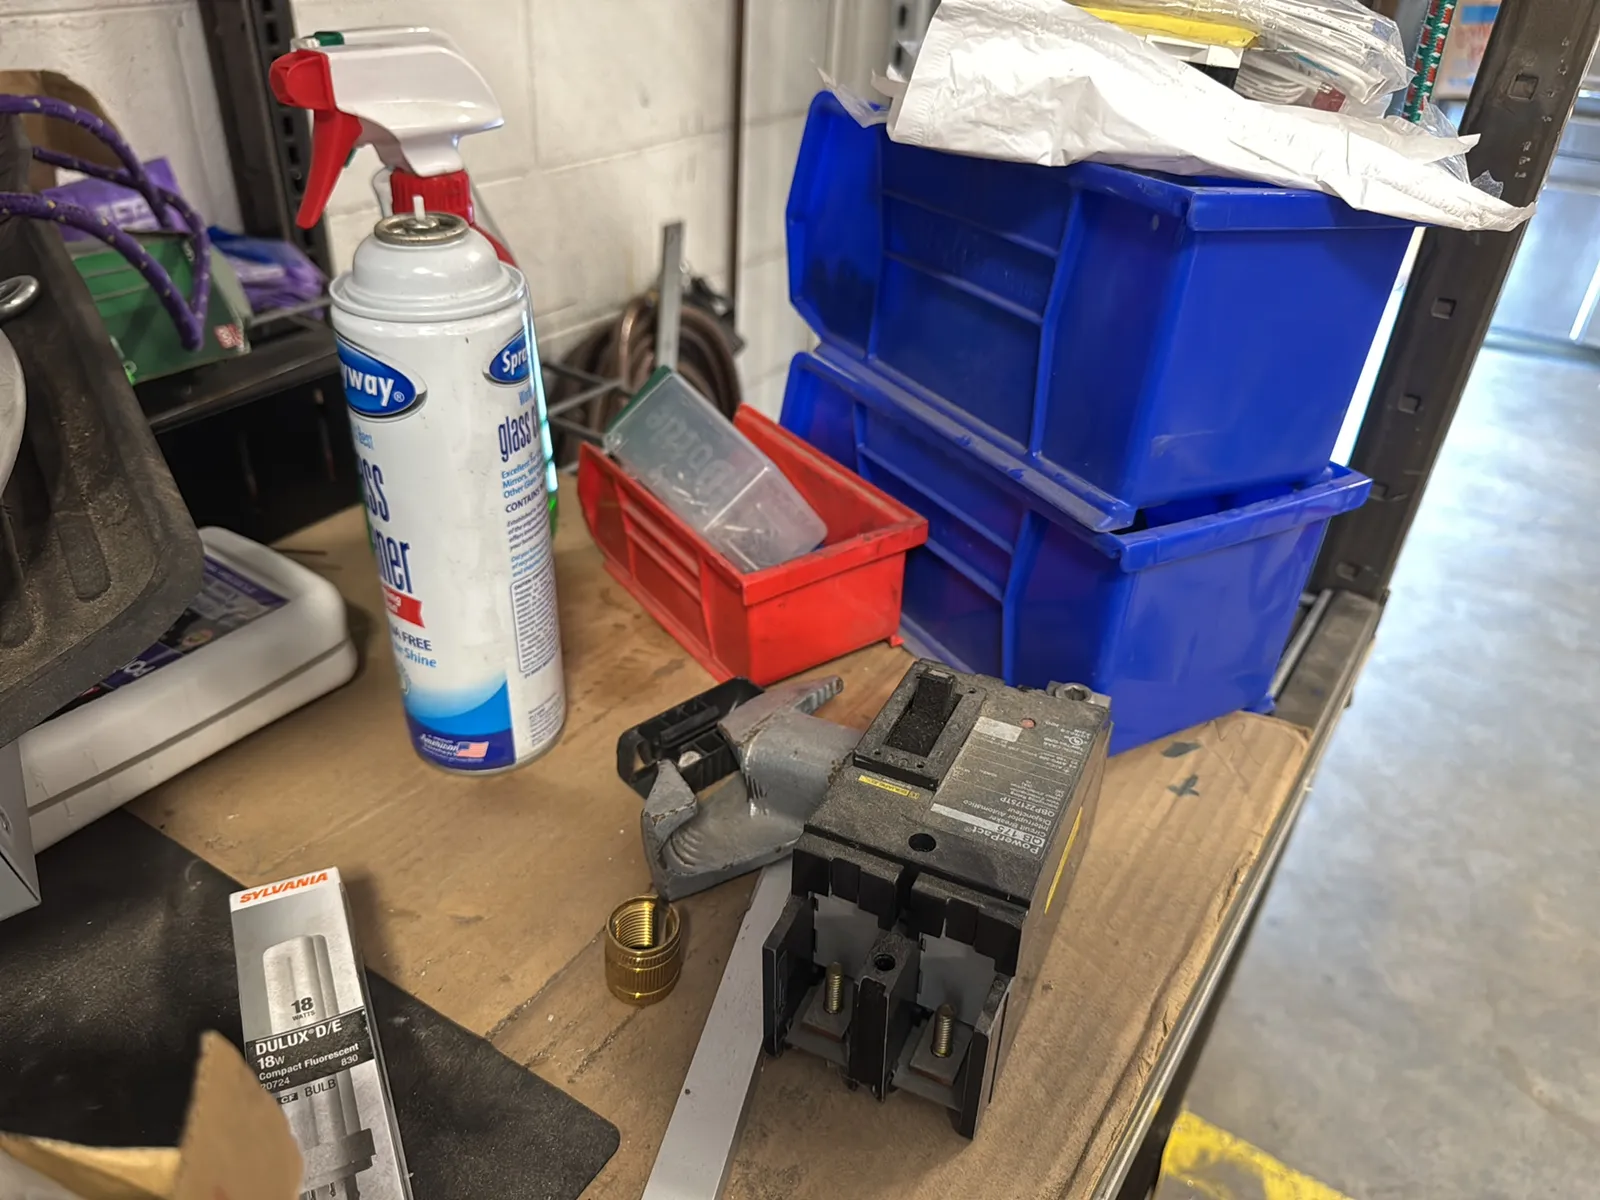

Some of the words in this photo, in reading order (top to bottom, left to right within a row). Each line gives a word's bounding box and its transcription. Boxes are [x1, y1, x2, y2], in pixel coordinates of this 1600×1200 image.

[498, 411, 532, 463] glass
[503, 486, 524, 499] Other
[402, 631, 433, 652] FREE
[404, 647, 438, 668] Shine
[988, 815, 1018, 828] Breaker
[1007, 807, 1051, 826] Disjoncteur
[1008, 814, 1049, 832] Interruptor
[972, 825, 1040, 855] PowerPact
[996, 825, 1017, 838] 175
[1019, 824, 1047, 838] Circuit
[1022, 835, 1044, 847] QB
[240, 872, 328, 904] SYLVANIA
[291, 996, 314, 1014] 18
[292, 1010, 315, 1021] WATTS
[255, 1029, 310, 1056] DULUX
[315, 1019, 342, 1039] D/E
[259, 1062, 302, 1081] Compact
[304, 1042, 359, 1068] Fluorescent
[341, 1054, 359, 1066] 830
[281, 1093, 297, 1104] CF
[304, 1079, 336, 1097] BULB
